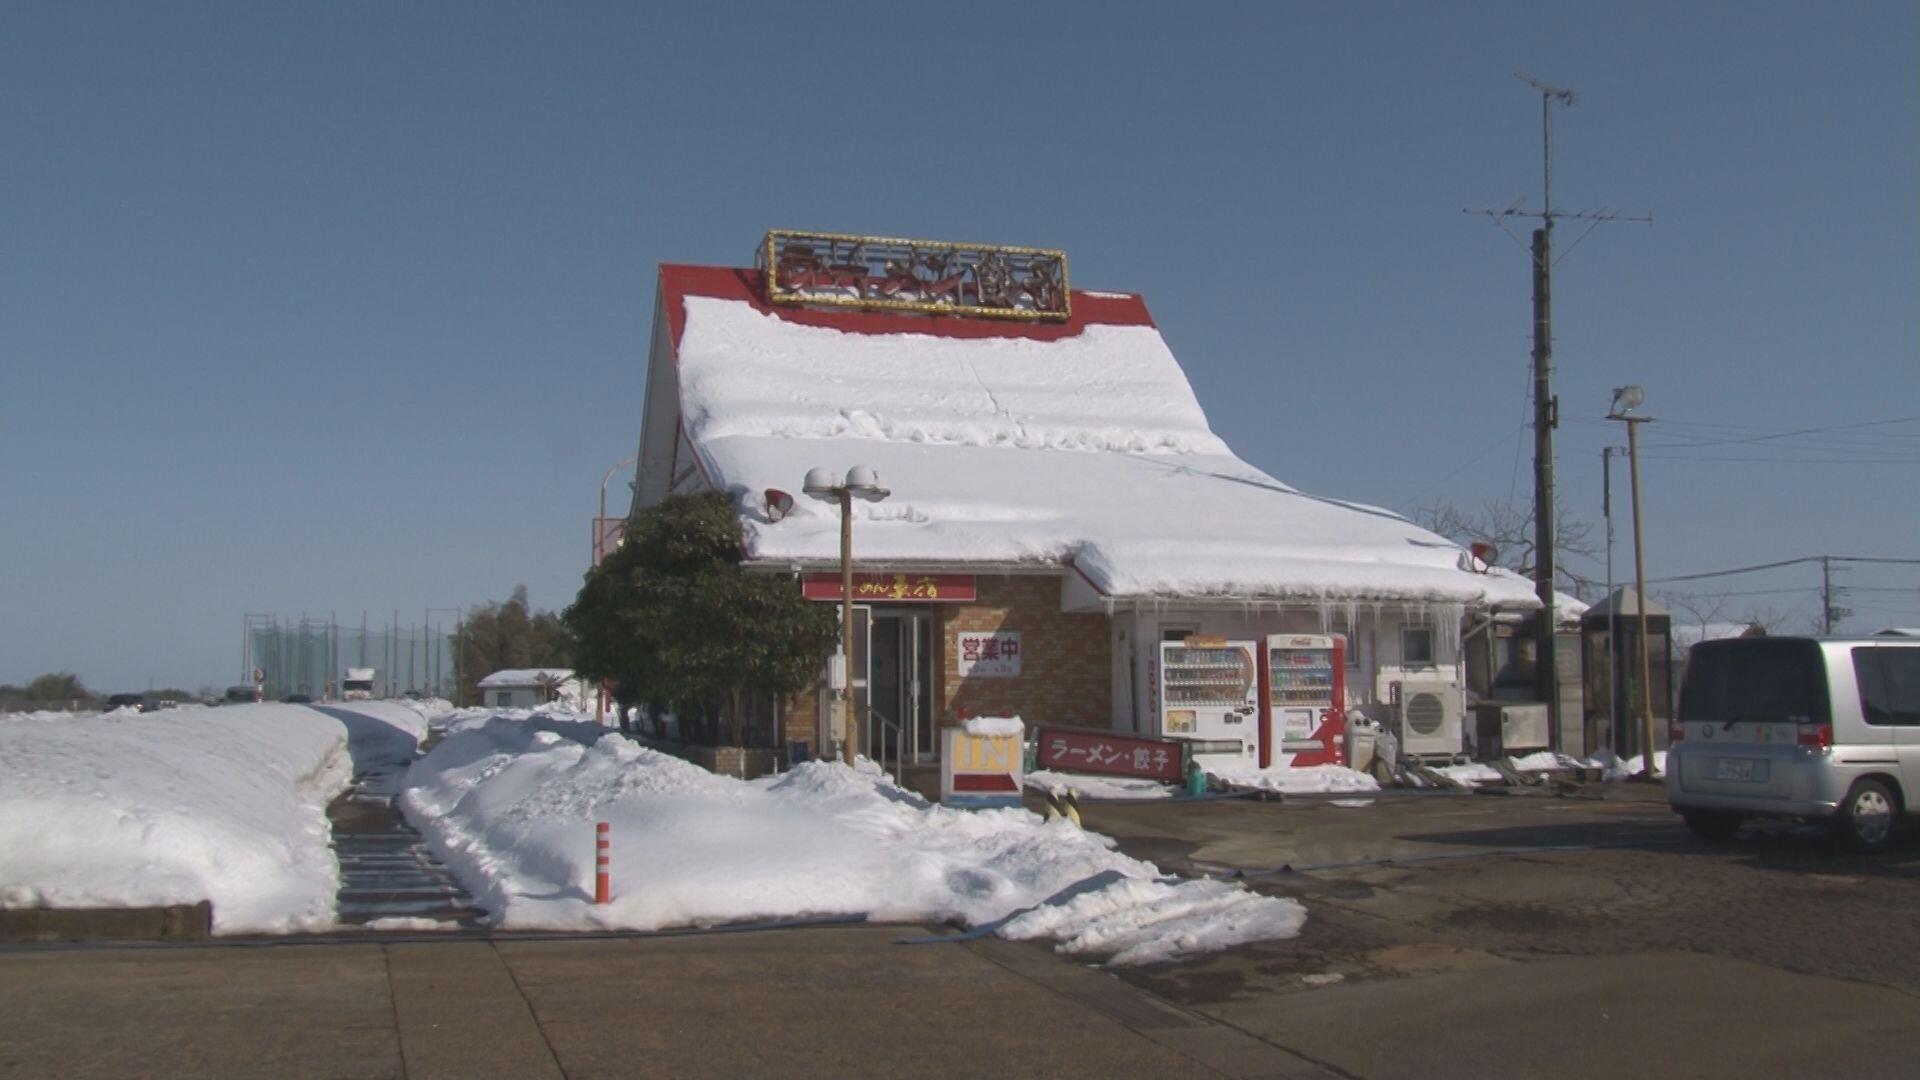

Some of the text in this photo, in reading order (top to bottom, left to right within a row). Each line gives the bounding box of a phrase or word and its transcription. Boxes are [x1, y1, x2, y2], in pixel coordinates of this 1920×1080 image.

[963, 637, 1018, 661] 営業中
[964, 736, 1009, 769] IN
[1051, 739, 1169, 771] ラーメン・餃子
